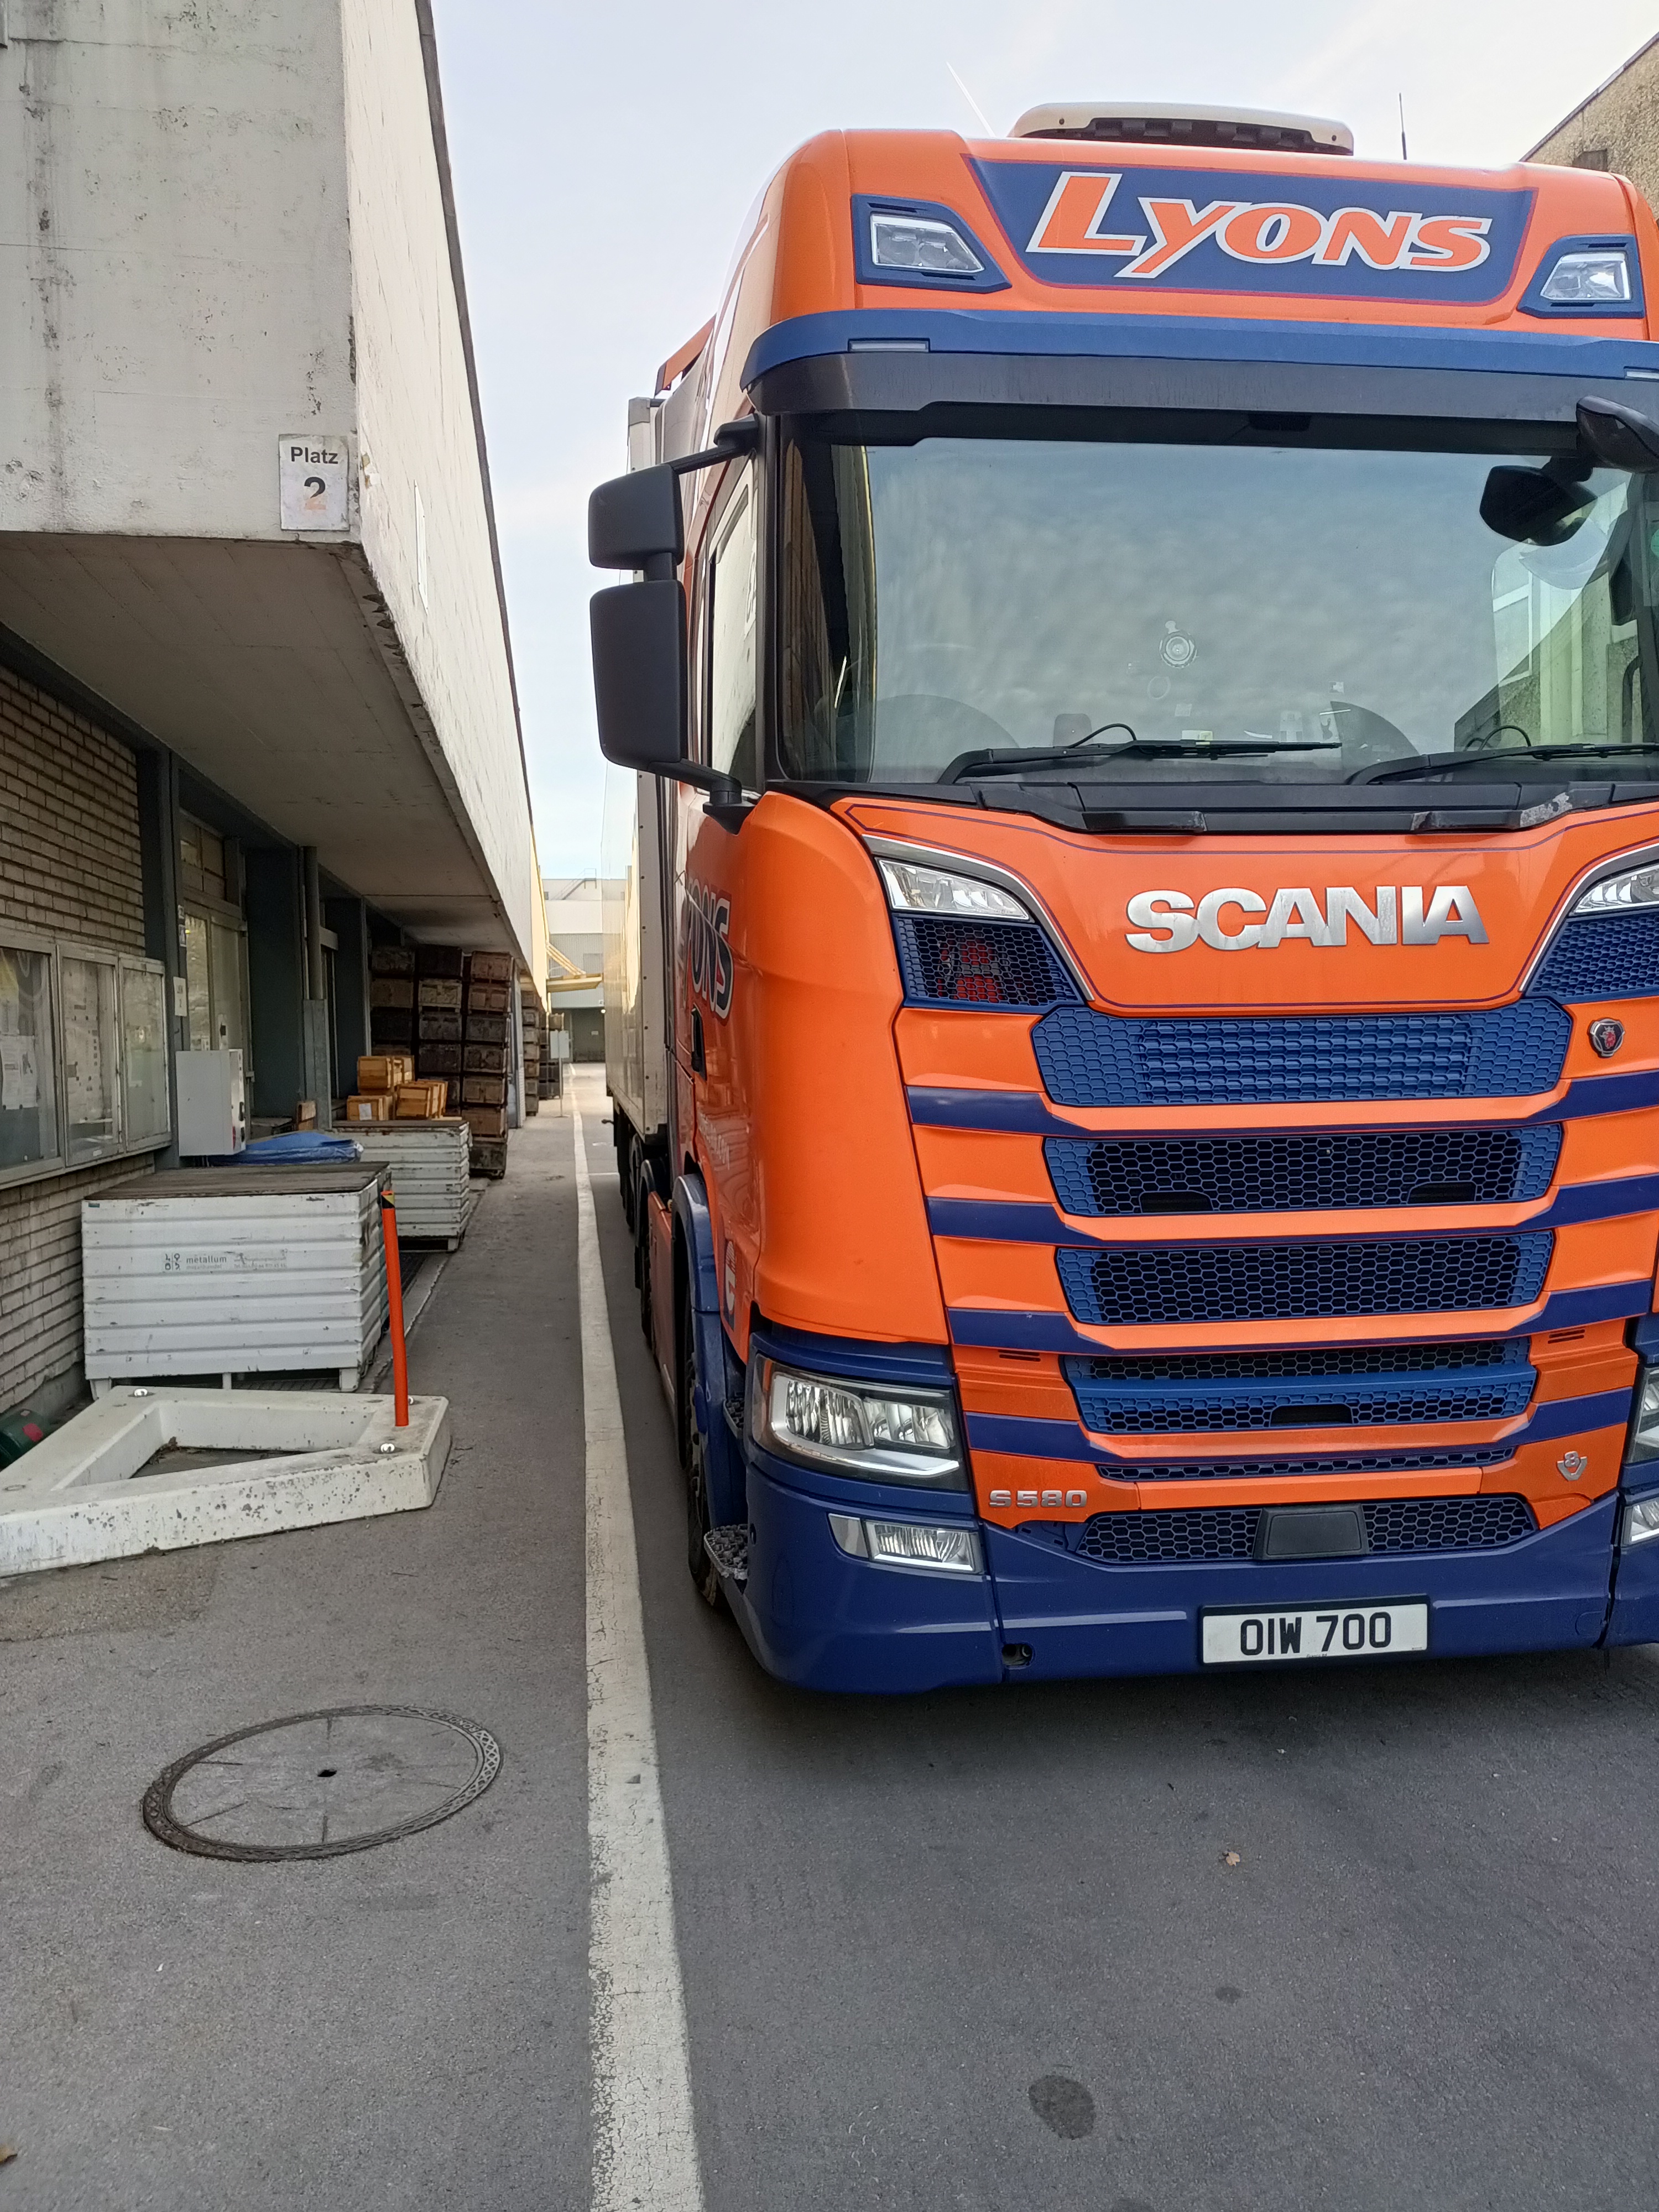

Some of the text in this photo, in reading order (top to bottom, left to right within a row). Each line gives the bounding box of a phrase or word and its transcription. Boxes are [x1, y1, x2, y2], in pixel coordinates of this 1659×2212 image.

[290, 446, 338, 464] Platz
[304, 476, 326, 510] 2
[1124, 885, 1489, 953] SCANIA
[1316, 1611, 1391, 1652] 700
